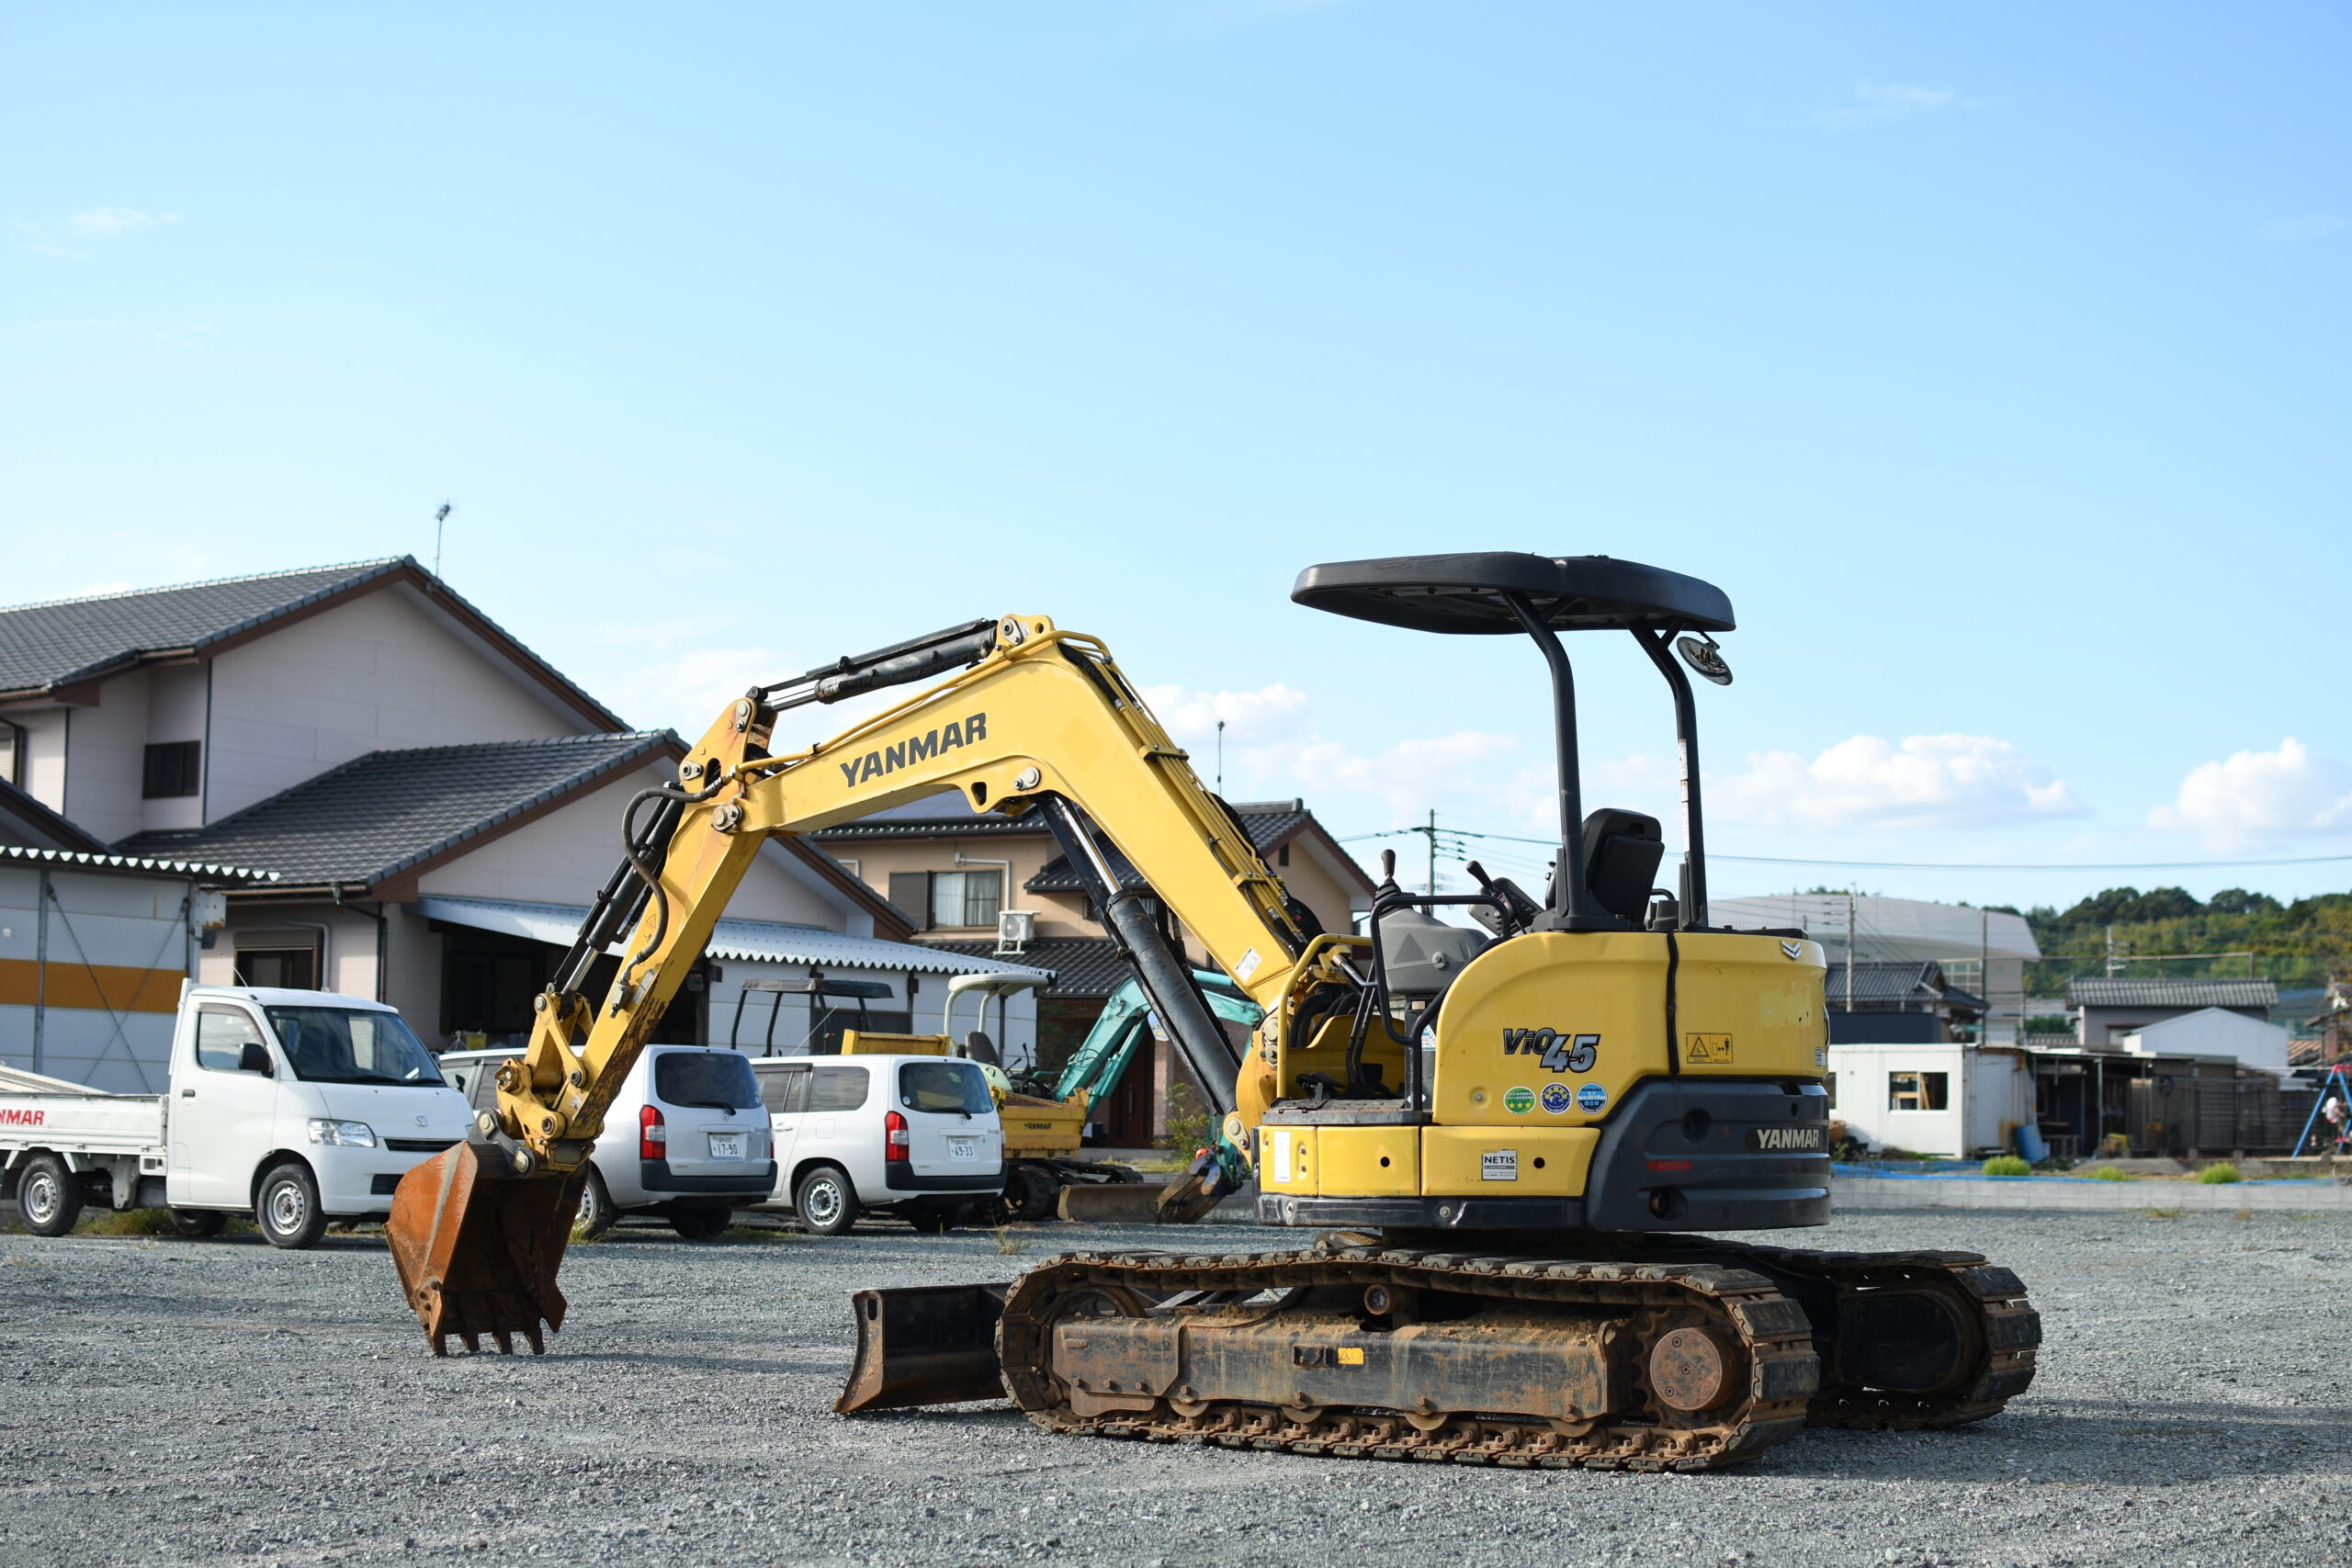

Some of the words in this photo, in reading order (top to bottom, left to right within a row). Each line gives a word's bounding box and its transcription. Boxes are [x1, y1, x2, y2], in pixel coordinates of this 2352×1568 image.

[840, 712, 987, 788] YANMAR
[1757, 1129, 1819, 1148] YANMAR
[1484, 1156, 1515, 1164] NETIS
